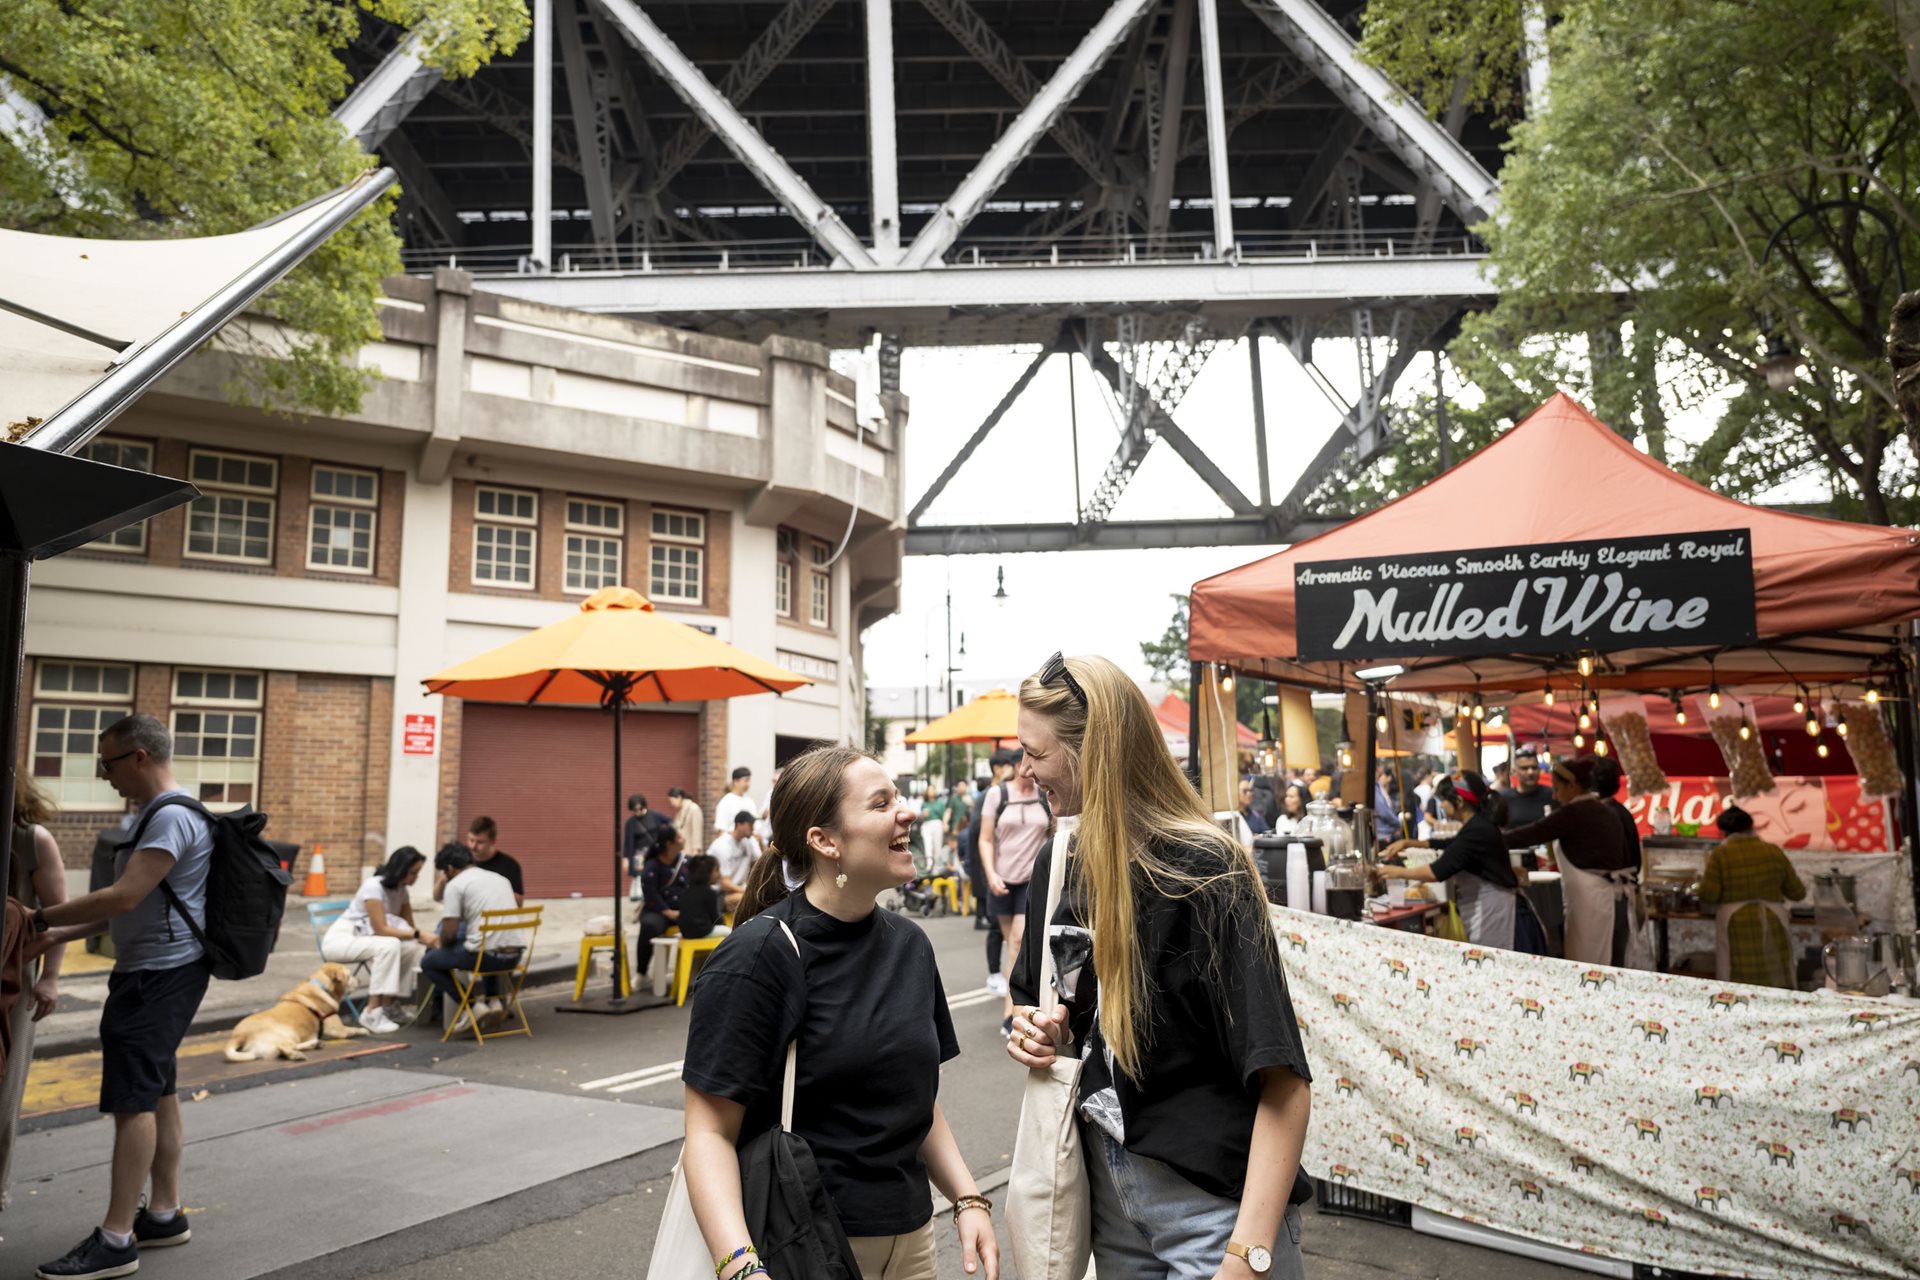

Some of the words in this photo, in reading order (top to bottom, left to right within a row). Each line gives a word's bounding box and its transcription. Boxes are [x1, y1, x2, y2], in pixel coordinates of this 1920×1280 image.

[1296, 565, 1373, 586] Aromatic
[1377, 561, 1451, 580] Viscous
[1455, 553, 1525, 575] Smooth
[1529, 549, 1591, 571] Earthy
[1597, 542, 1672, 569] Elegant
[1678, 536, 1744, 563] Royal
[1332, 577, 1529, 650] Mulled
[1532, 571, 1709, 637] Wine
